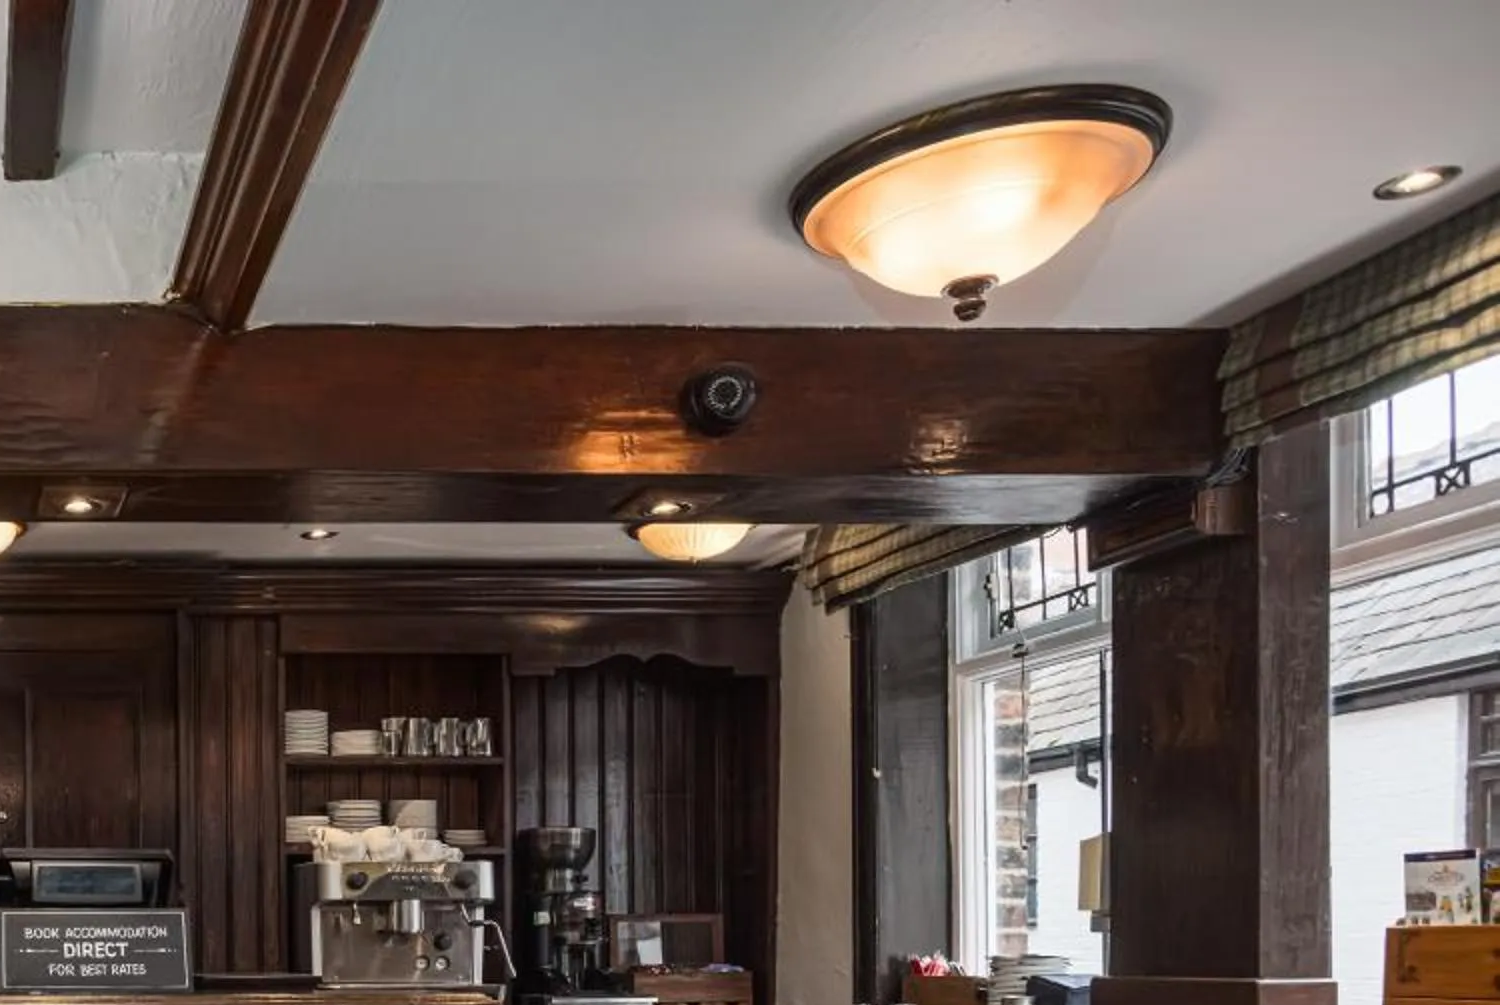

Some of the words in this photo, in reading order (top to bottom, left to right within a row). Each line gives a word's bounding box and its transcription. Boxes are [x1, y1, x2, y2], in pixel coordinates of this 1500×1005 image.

[23, 927, 59, 939] BOOK
[65, 926, 168, 939] ACCOMMODATION
[63, 942, 129, 959] DIRECT
[48, 963, 75, 976] FOR
[81, 963, 107, 976] BEST
[111, 963, 147, 975] RATES
